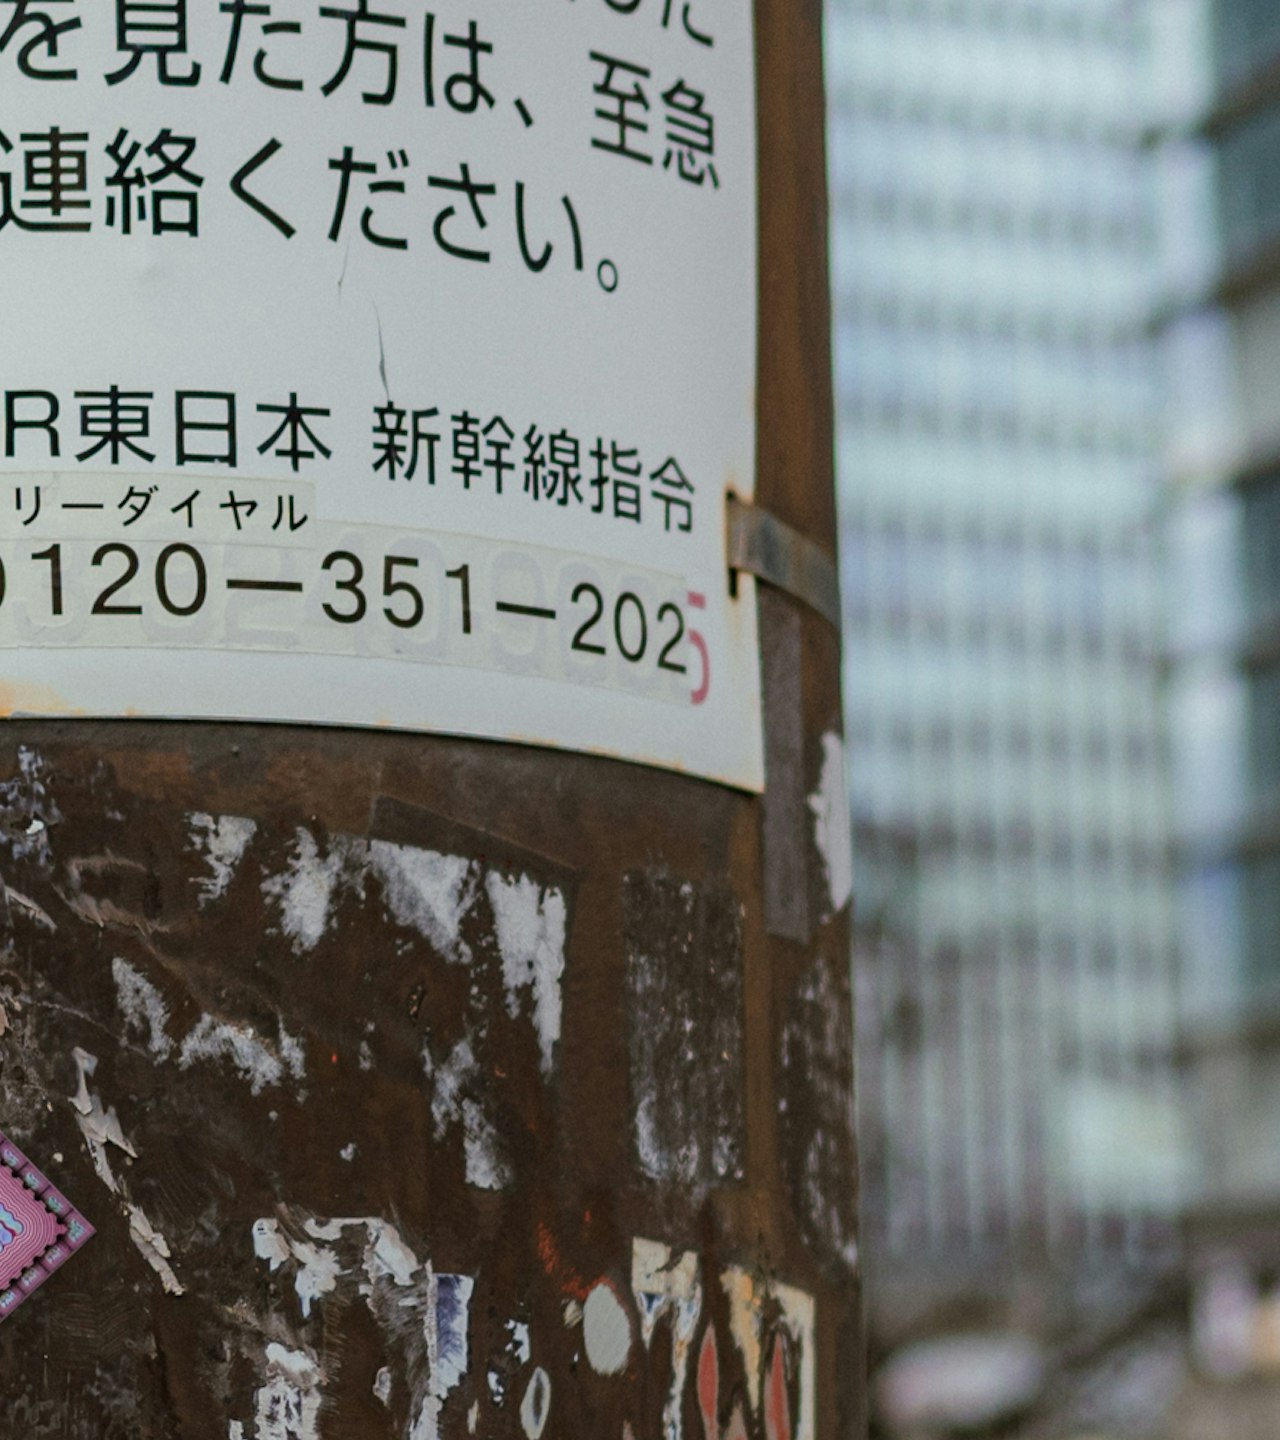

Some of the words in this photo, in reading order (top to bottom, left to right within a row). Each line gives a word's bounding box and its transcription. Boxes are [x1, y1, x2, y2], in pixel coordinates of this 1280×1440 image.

[370, 399, 697, 536] 新幹線指令
